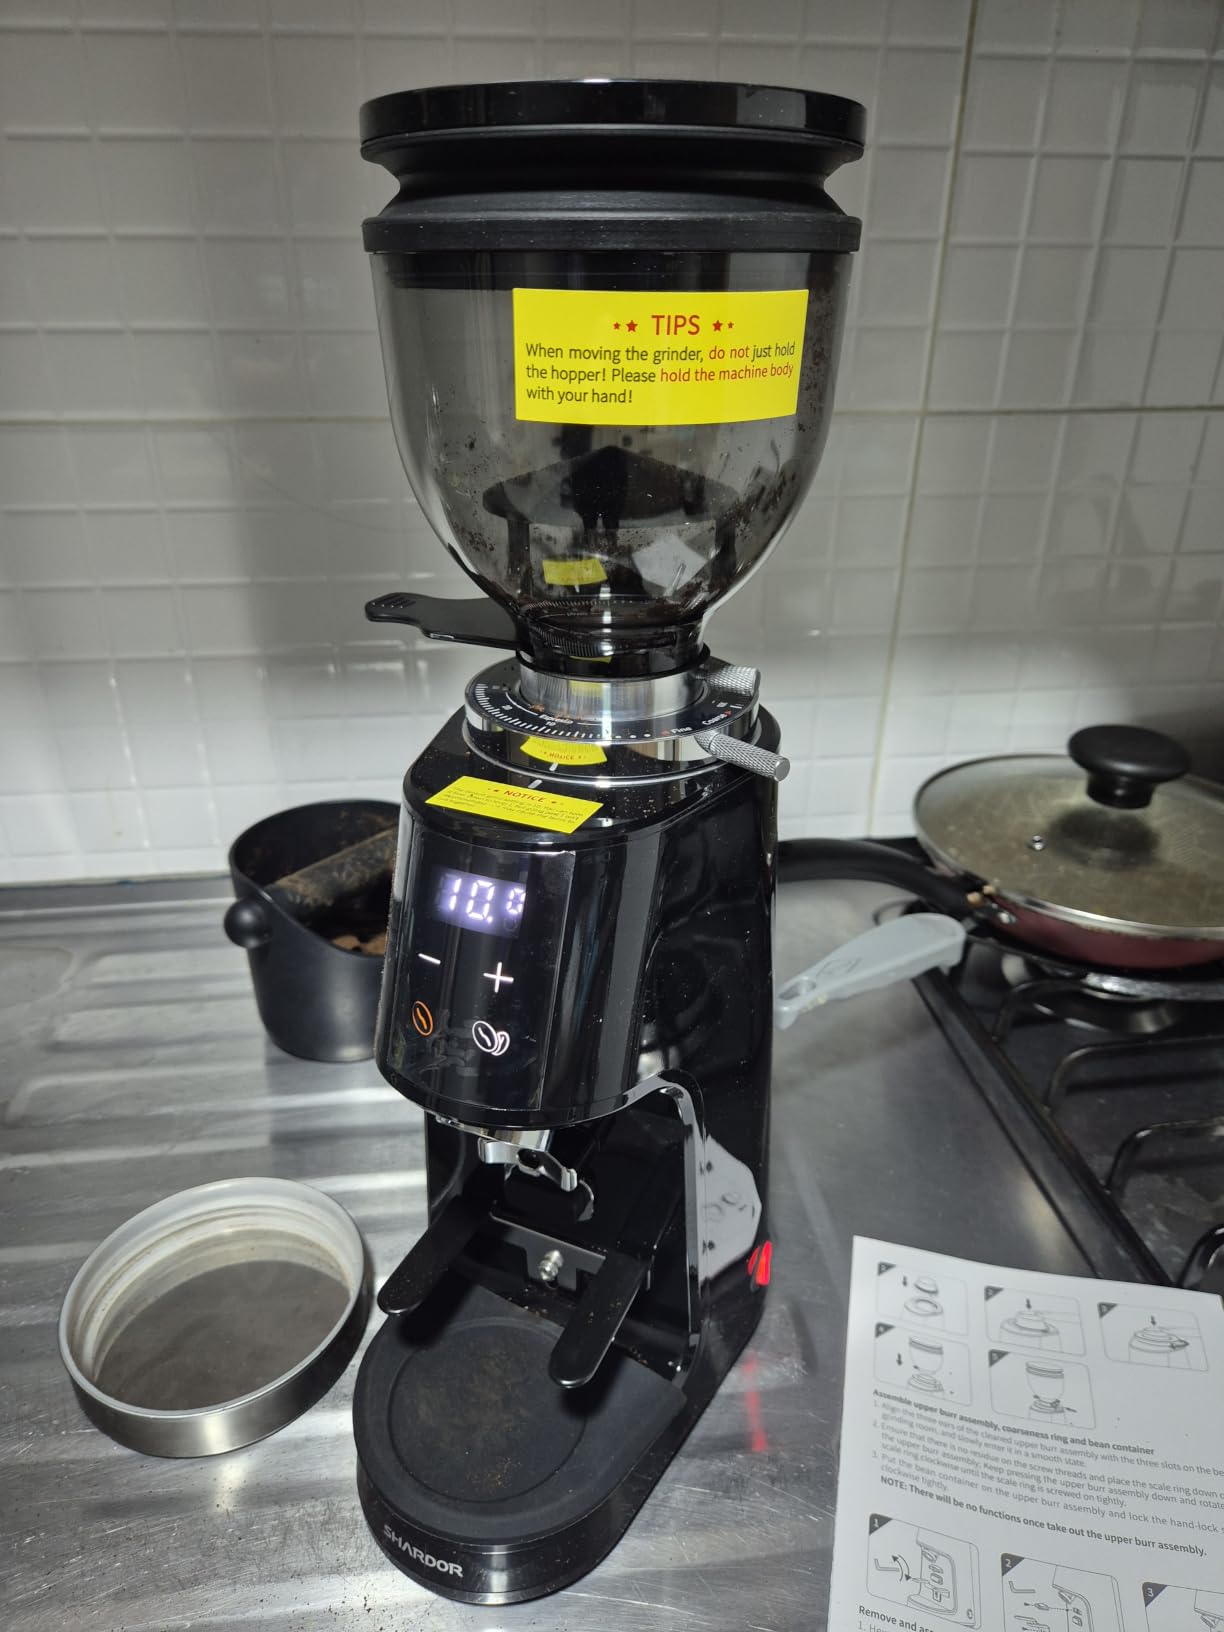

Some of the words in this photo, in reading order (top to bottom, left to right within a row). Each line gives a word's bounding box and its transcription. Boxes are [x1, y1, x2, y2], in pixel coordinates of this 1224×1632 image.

[651, 314, 700, 336] TIPS
[526, 343, 563, 358] When
[568, 345, 621, 364] moving
[625, 345, 648, 361] the
[653, 345, 704, 364] grinder,
[708, 345, 726, 360] do
[730, 344, 750, 359] not
[751, 343, 772, 362] just
[775, 341, 795, 356] hold
[526, 364, 548, 379] the
[551, 365, 606, 384] hopper!
[612, 368, 656, 382] Please
[660, 368, 690, 382] hold
[694, 367, 715, 381] the
[718, 364, 768, 380] machine
[770, 362, 794, 378] body
[526, 386, 554, 401] with
[557, 392, 587, 404] your
[591, 388, 633, 403] hand!
[504, 789, 546, 803] NOTICE
[913, 1402, 937, 1413] upper
[939, 1407, 957, 1419] burr
[1050, 1433, 1069, 1444] ring
[1070, 1437, 1086, 1445] and
[1087, 1438, 1110, 1449] bean
[1111, 1443, 1154, 1455] container
[1100, 1453, 1119, 1463] with
[1120, 1455, 1135, 1464] the
[1161, 1460, 1182, 1471] slots
[1183, 1464, 1195, 1472] on
[1196, 1465, 1211, 1475] the
[981, 1471, 995, 1481] the
[996, 1476, 1018, 1487] scale
[1019, 1481, 1036, 1492] ring
[1046, 1487, 1081, 1499] screwed
[1083, 1493, 1095, 1501] on
[1096, 1494, 1127, 1508] tightly.
[983, 1462, 1005, 1475] Keep
[1006, 1469, 1041, 1484] pressing
[1043, 1475, 1058, 1484] the
[1060, 1479, 1085, 1490] upper
[1087, 1482, 1106, 1492] burr
[1108, 1486, 1150, 1501] assembly
[1151, 1492, 1177, 1503] down
[1179, 1497, 1197, 1506] and
[1001, 1458, 1012, 1466] on
[1014, 1459, 1027, 1469] the
[1089, 1473, 1105, 1482] and
[1107, 1475, 1130, 1486] place
[1132, 1479, 1147, 1488] the
[1148, 1482, 1171, 1492] scale
[1172, 1484, 1191, 1497] ring
[1192, 1487, 1218, 1499] down
[880, 1475, 908, 1491] NOTE:
[909, 1484, 934, 1499] There
[936, 1492, 952, 1505] will
[953, 1498, 964, 1508] be
[966, 1503, 978, 1512] no
[979, 1505, 1021, 1523] functions
[1022, 1518, 1045, 1529] once
[1046, 1522, 1067, 1533] take
[1068, 1527, 1085, 1537] out
[1086, 1529, 1103, 1539] the
[1104, 1533, 1133, 1545] upper
[1135, 1536, 1156, 1548] burr
[1158, 1542, 1207, 1557] assembly.
[981, 1484, 993, 1493] on
[995, 1488, 1010, 1498] the
[1012, 1492, 1038, 1504] upper
[1041, 1497, 1061, 1508] burr
[1063, 1502, 1106, 1518] assembly
[1108, 1510, 1126, 1519] and
[1129, 1511, 1150, 1523] lock
[1151, 1515, 1167, 1525] the
[1169, 1517, 1219, 1532] hand-lock
[873, 1518, 879, 1528] 1
[383, 1524, 464, 1578] SHARDOR
[1005, 1558, 1012, 1568] 2
[1146, 1587, 1154, 1597] 3
[858, 1605, 897, 1625] Remove
[898, 1619, 917, 1632] and
